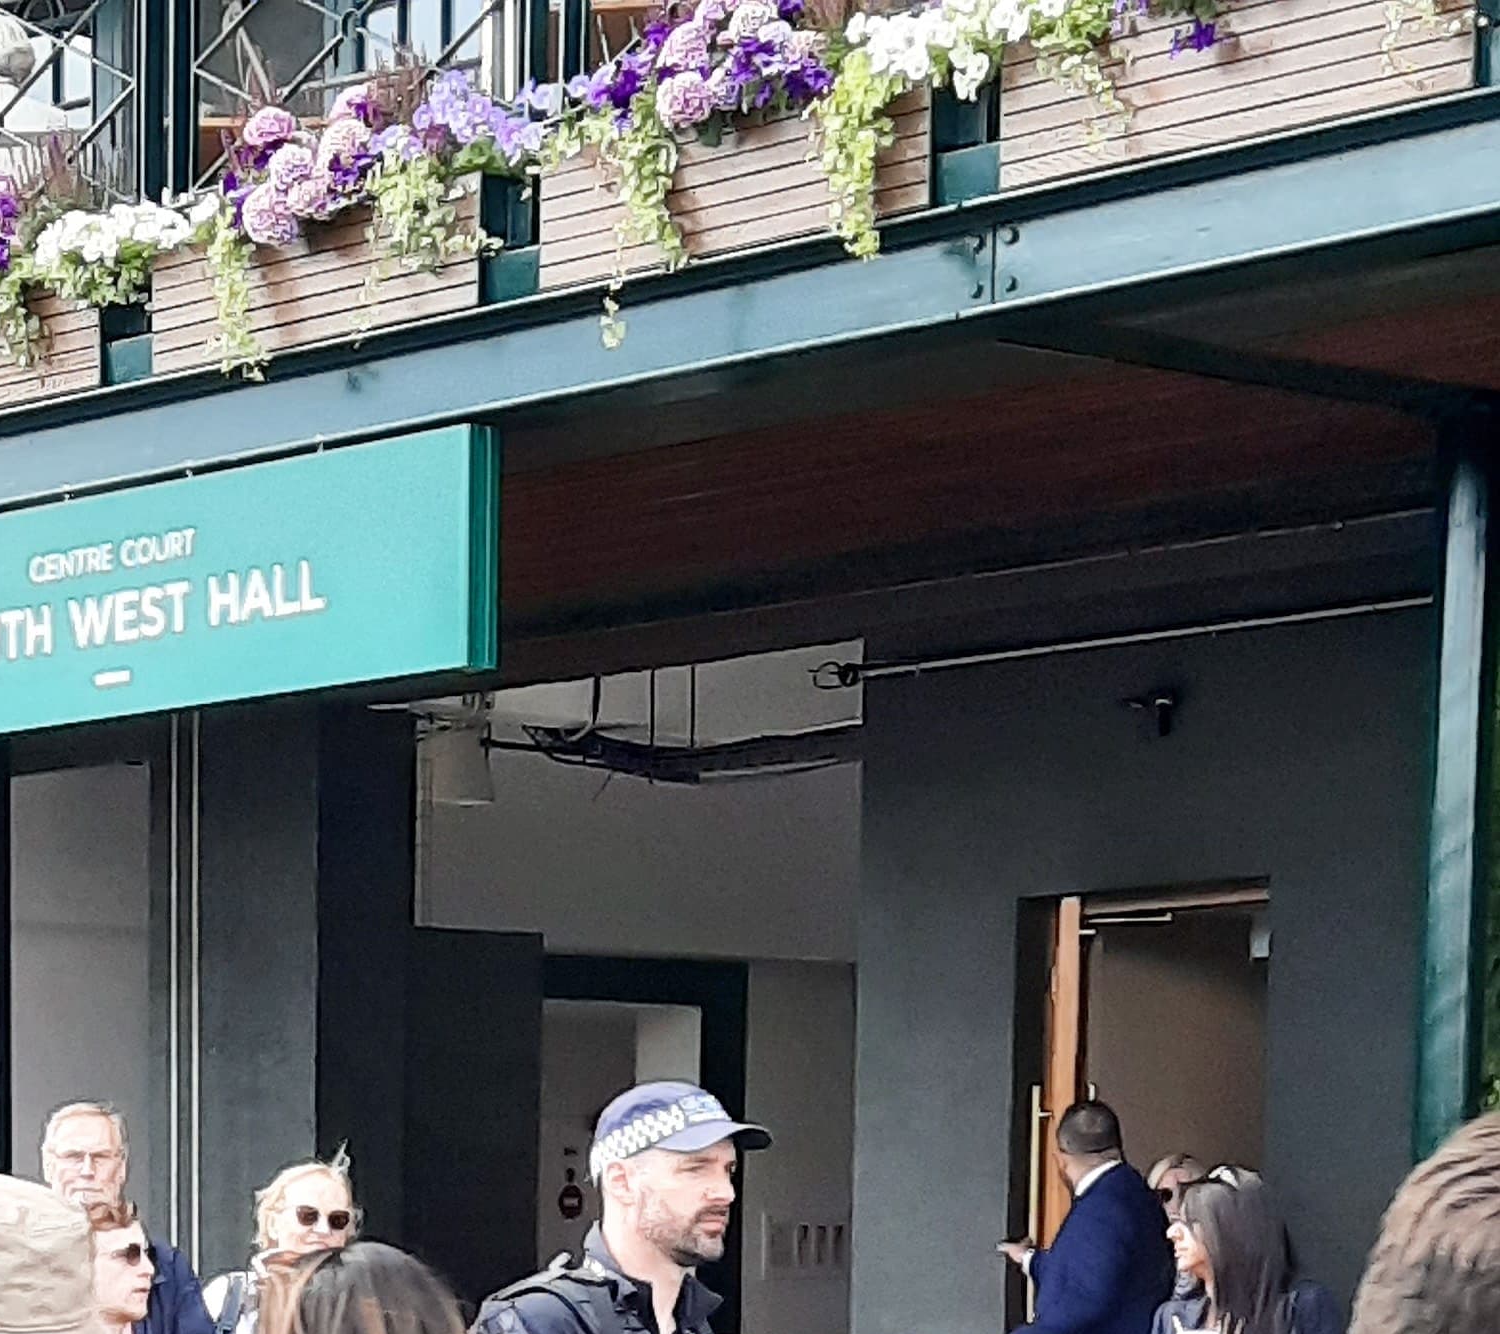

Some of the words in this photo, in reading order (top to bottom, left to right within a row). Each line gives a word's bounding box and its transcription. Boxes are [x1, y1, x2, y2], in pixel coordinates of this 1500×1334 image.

[28, 542, 114, 584] CENTRE
[119, 527, 197, 568] COURT
[67, 580, 192, 650] WEST
[207, 560, 327, 627] HALL
